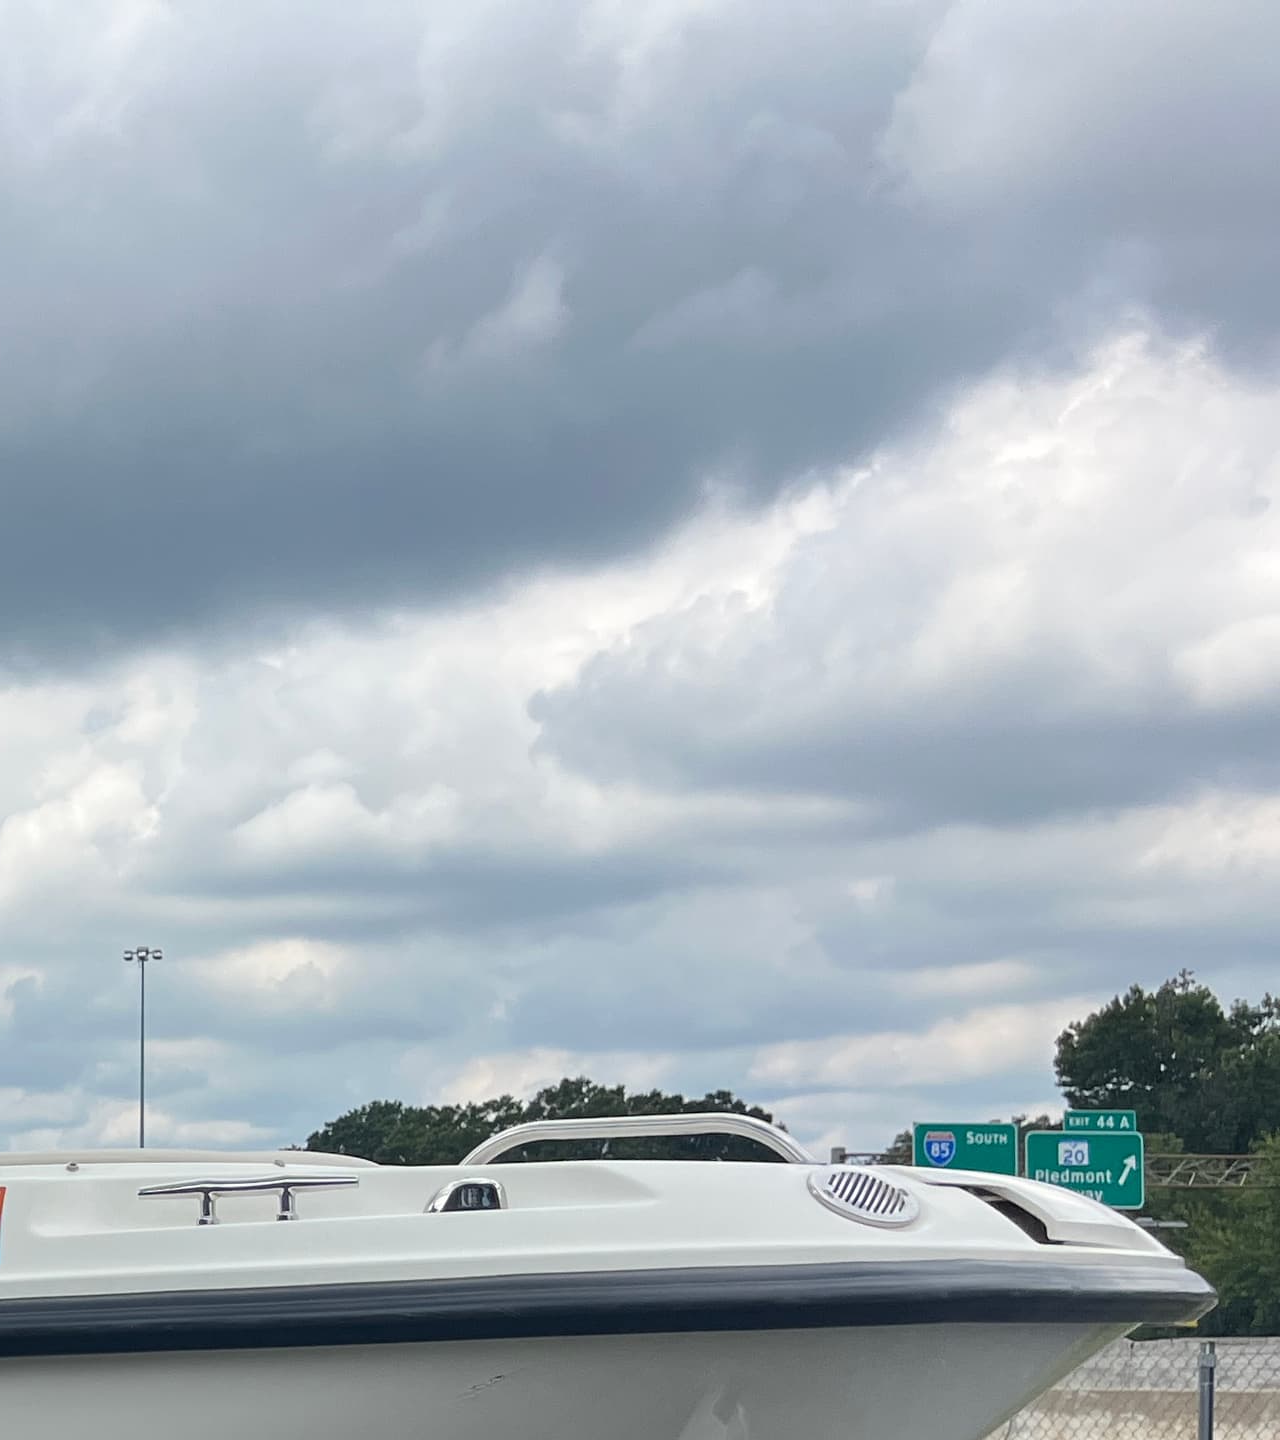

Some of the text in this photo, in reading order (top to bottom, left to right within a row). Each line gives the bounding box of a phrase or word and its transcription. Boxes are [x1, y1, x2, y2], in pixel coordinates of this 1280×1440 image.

[1069, 1115, 1130, 1129] EXIT 44 A
[931, 1142, 950, 1158] 85
[1063, 1150, 1085, 1165] 20
[1035, 1169, 1112, 1184] Piedmont
